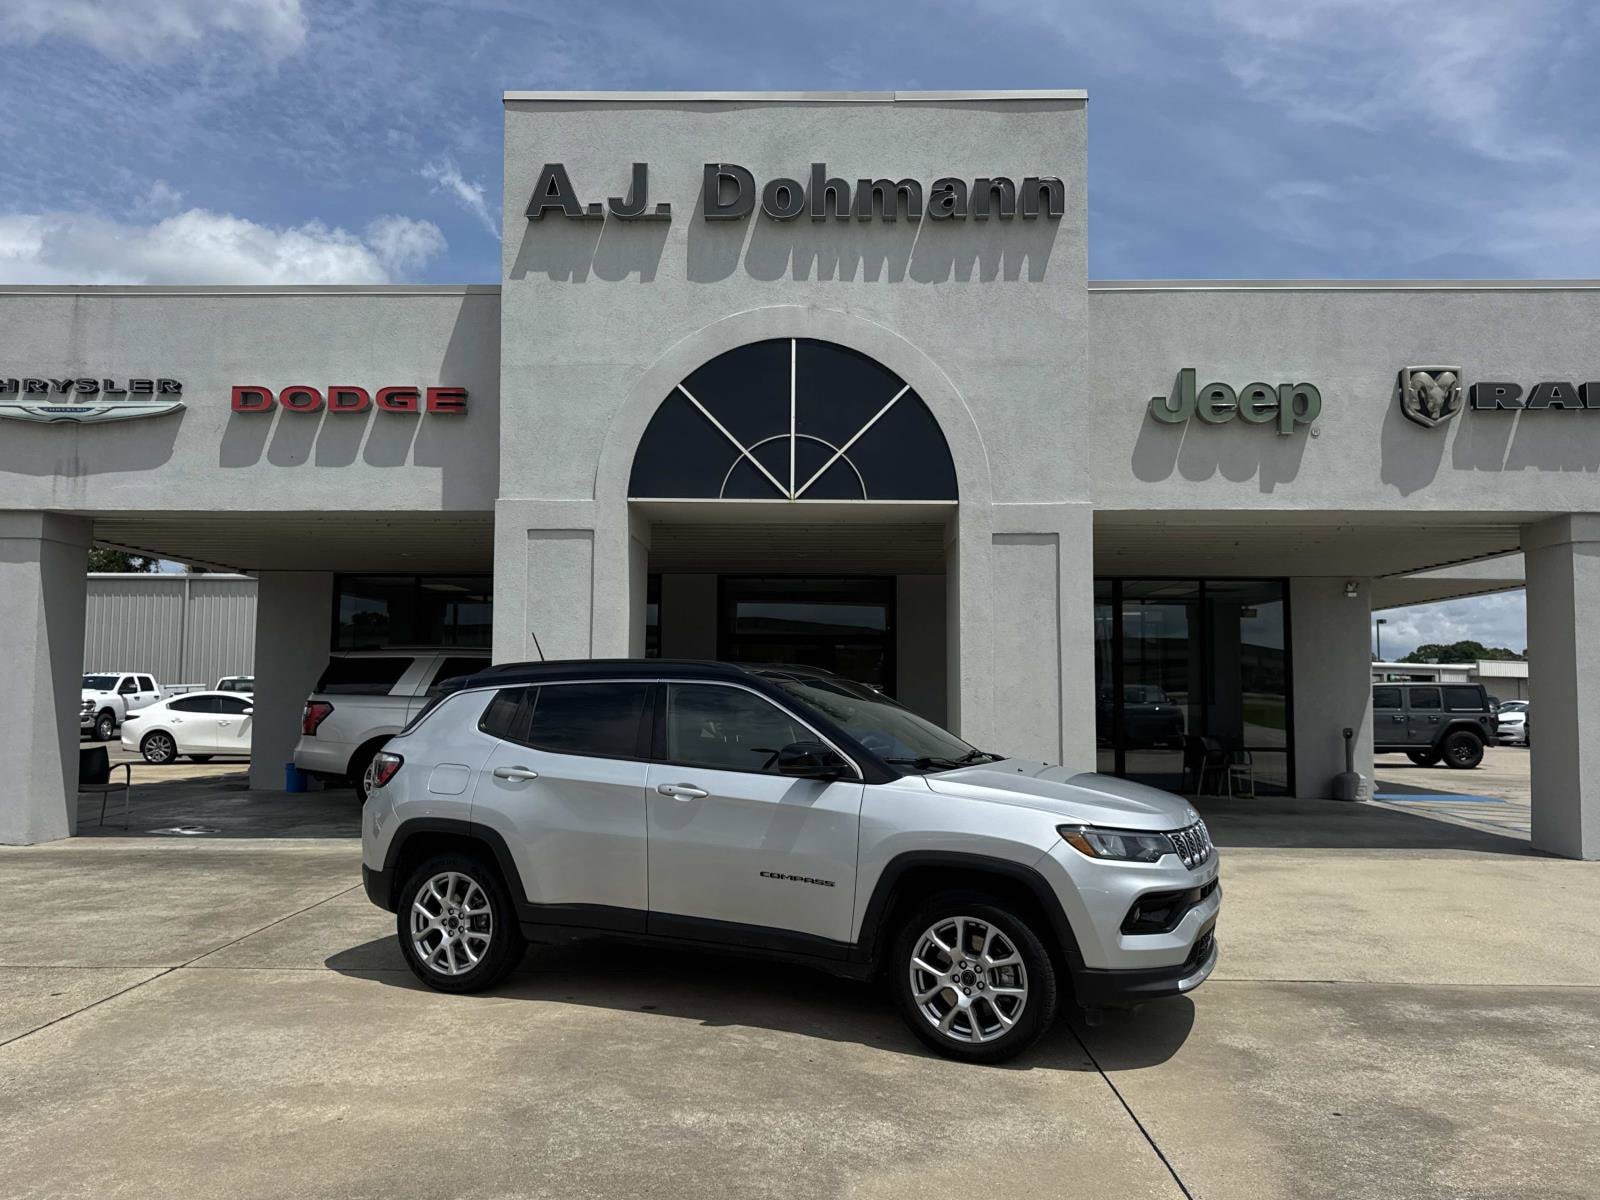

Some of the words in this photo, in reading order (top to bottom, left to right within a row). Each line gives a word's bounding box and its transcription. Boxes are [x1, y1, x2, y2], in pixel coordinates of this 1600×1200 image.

[525, 163, 671, 220] A.J.
[703, 162, 1065, 220] Dohmann
[0, 378, 182, 393] HRYSLER
[1470, 382, 1600, 410] RA
[231, 386, 467, 414] DODGE
[1151, 368, 1321, 434] Jeep
[760, 871, 835, 887] COMPASS
